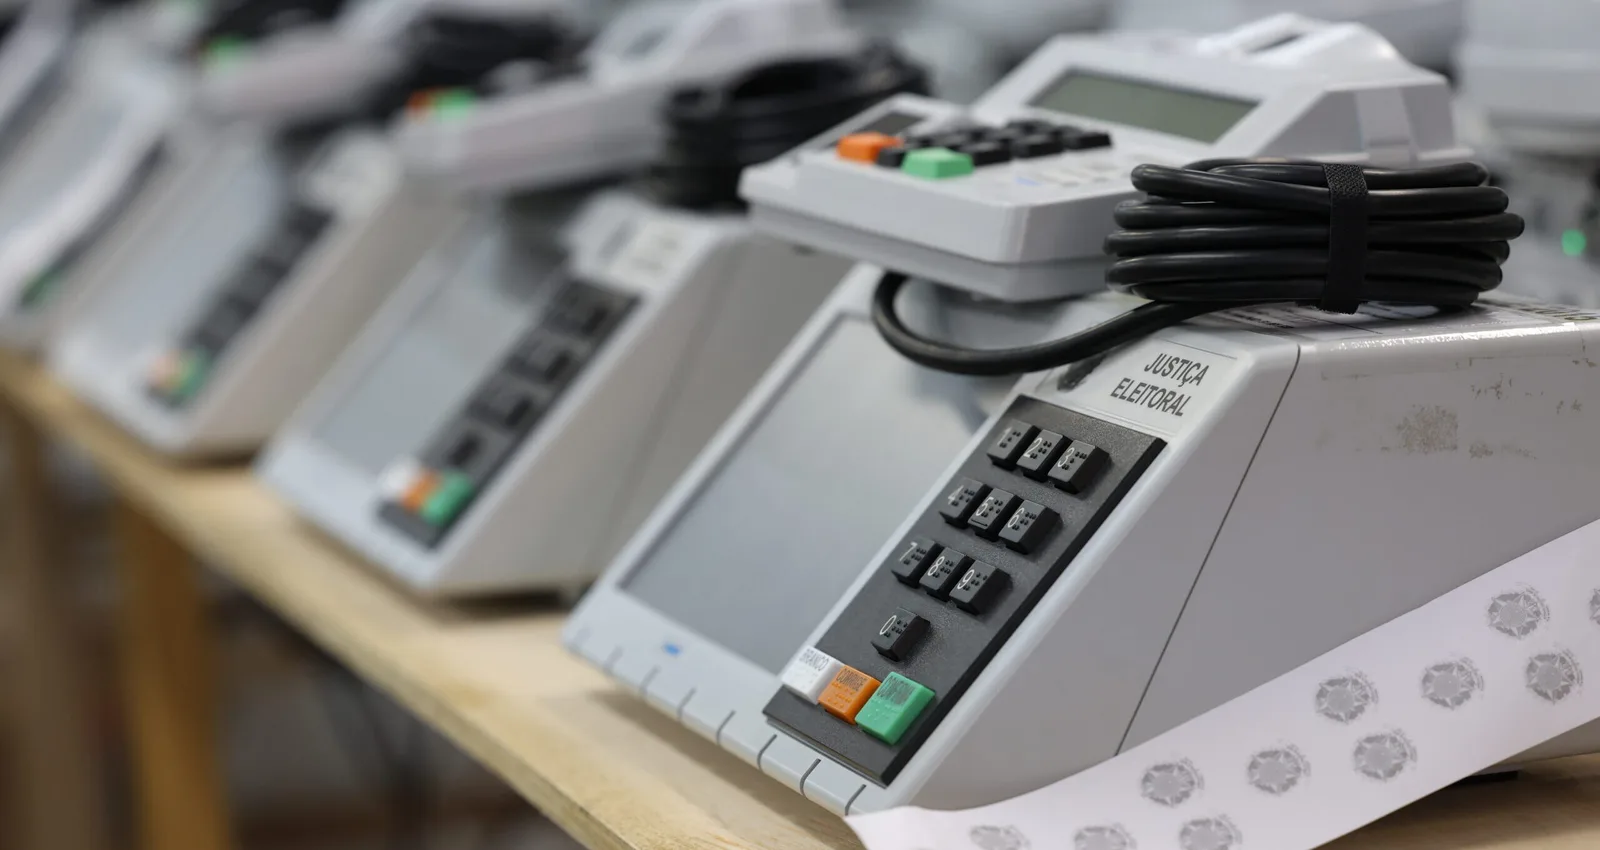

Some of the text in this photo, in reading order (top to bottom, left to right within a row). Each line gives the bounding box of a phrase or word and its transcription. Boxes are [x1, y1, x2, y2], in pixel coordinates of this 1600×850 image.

[1144, 353, 1210, 388] JUSTIÇA
[1110, 377, 1191, 417] ELEITORAL
[997, 427, 1075, 468] 1 2 3
[947, 485, 1025, 528] 4 5 6
[899, 541, 975, 589] 7 8 9
[879, 615, 897, 635] 0
[799, 648, 829, 671] BRANCO
